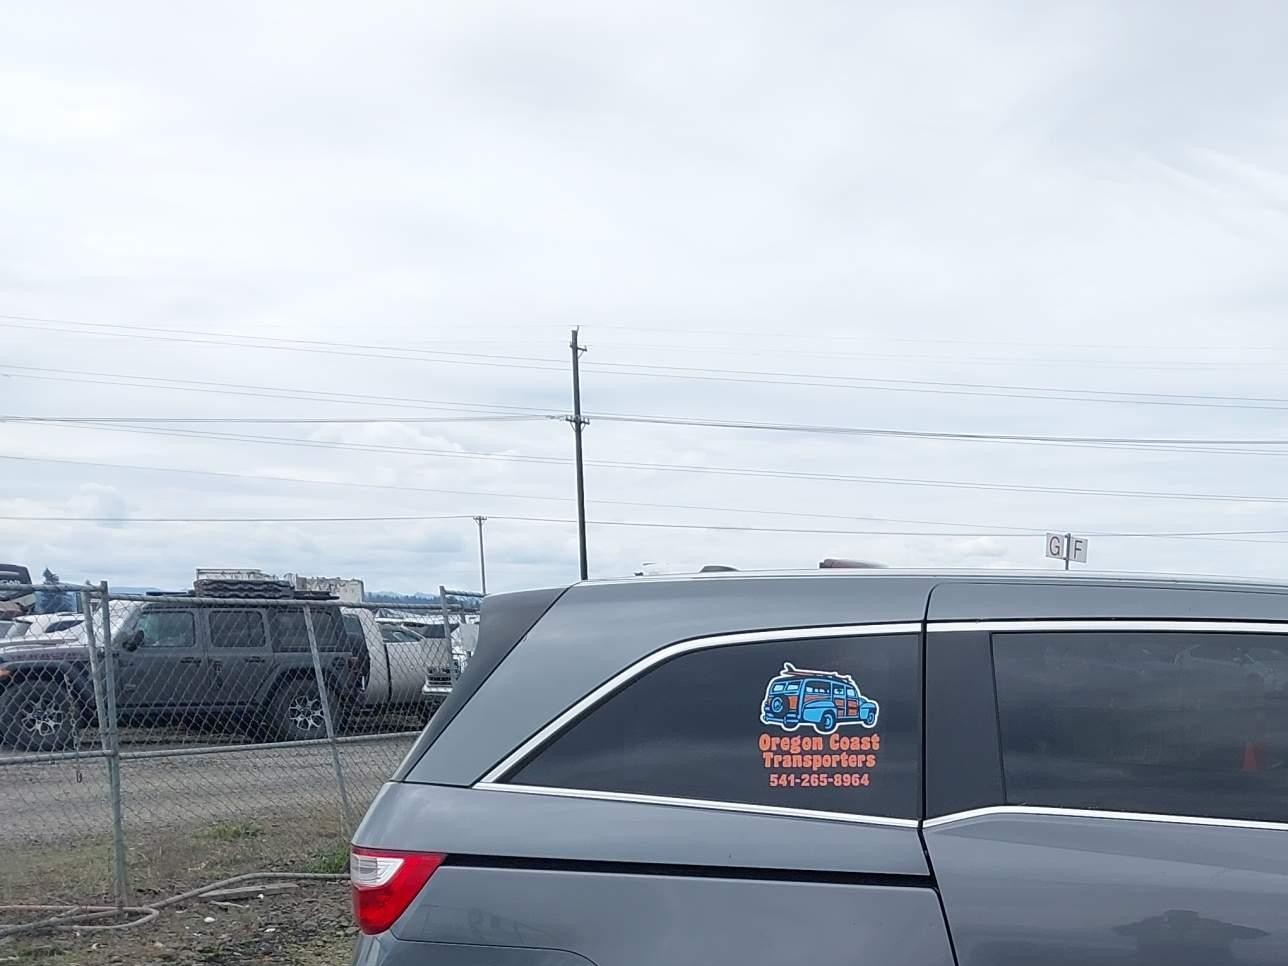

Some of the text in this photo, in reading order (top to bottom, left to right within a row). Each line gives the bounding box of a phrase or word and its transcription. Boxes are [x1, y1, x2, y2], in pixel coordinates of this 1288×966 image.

[1050, 536, 1060, 556] G
[1074, 540, 1083, 559] F
[759, 734, 880, 754] Oregon Coast
[762, 752, 876, 770] Transporters
[769, 774, 869, 787] 541-265-8964
